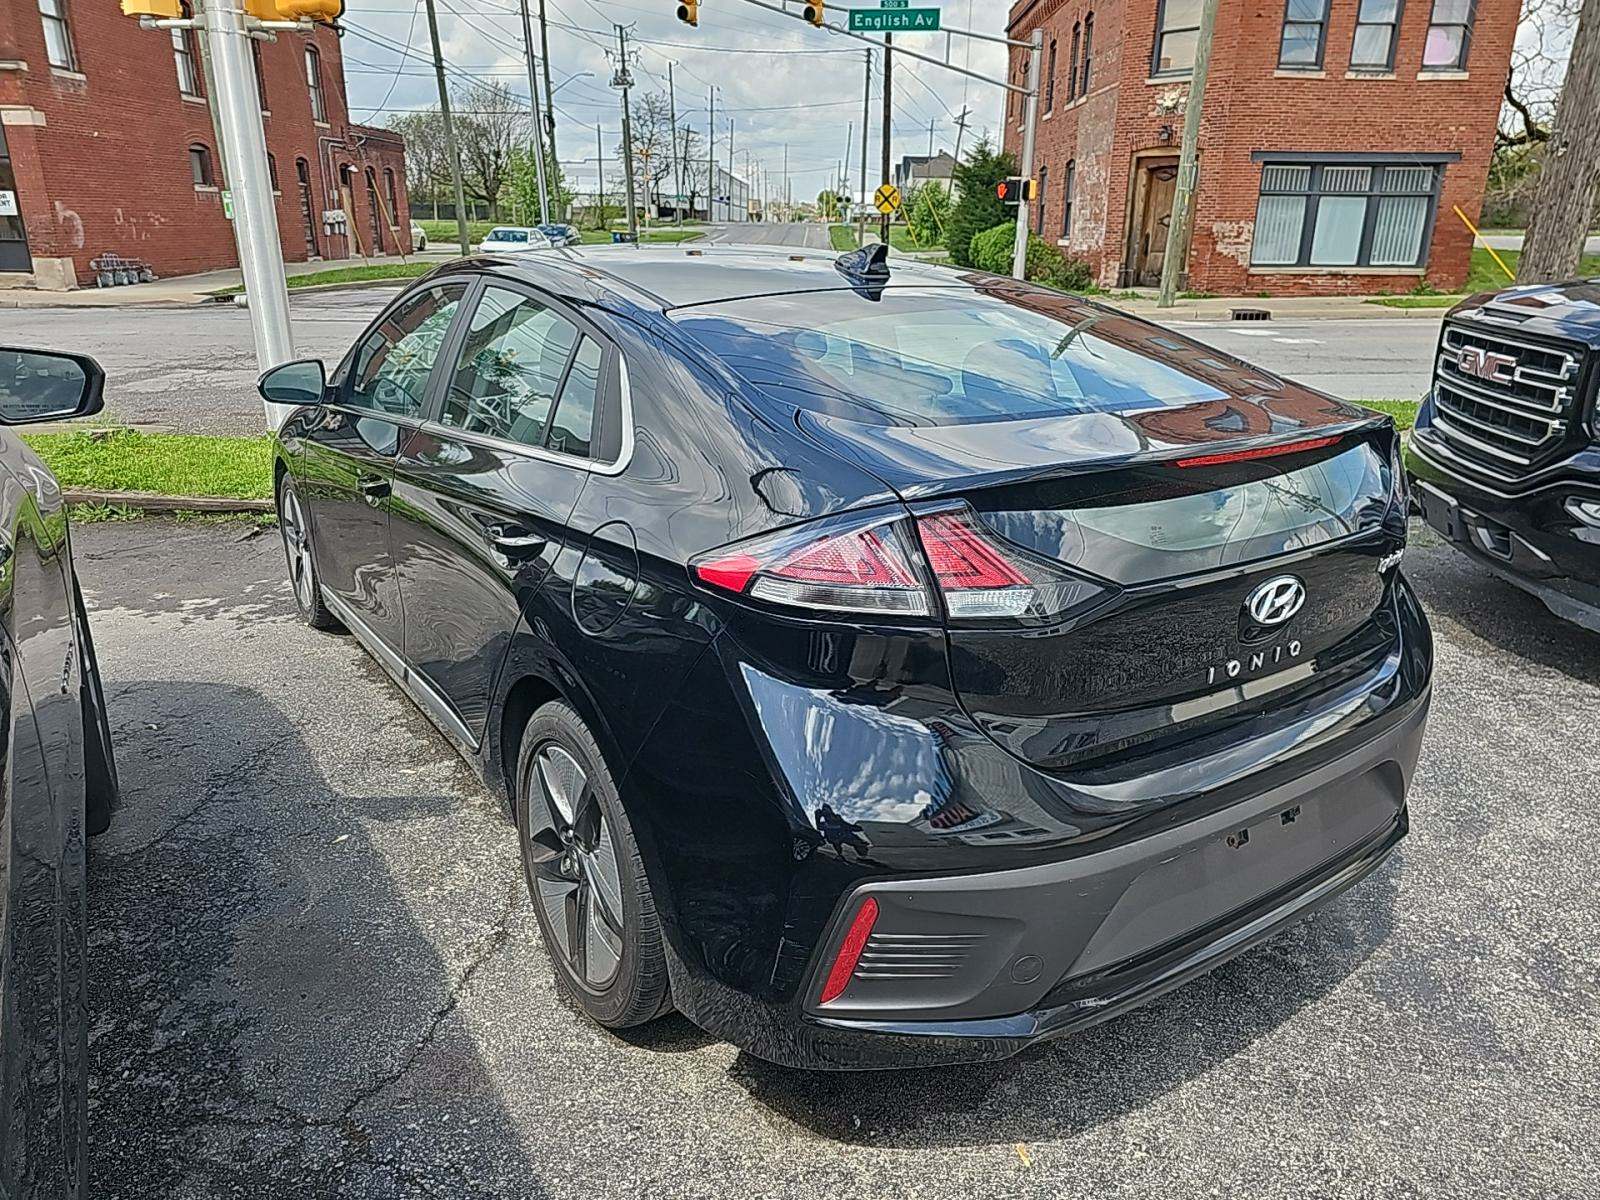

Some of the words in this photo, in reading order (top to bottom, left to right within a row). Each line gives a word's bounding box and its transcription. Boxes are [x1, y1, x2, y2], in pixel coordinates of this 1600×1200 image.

[854, 13, 909, 29] English
[914, 13, 934, 26] Av
[1458, 344, 1517, 387] GMC
[1207, 640, 1301, 685] IONIQ
